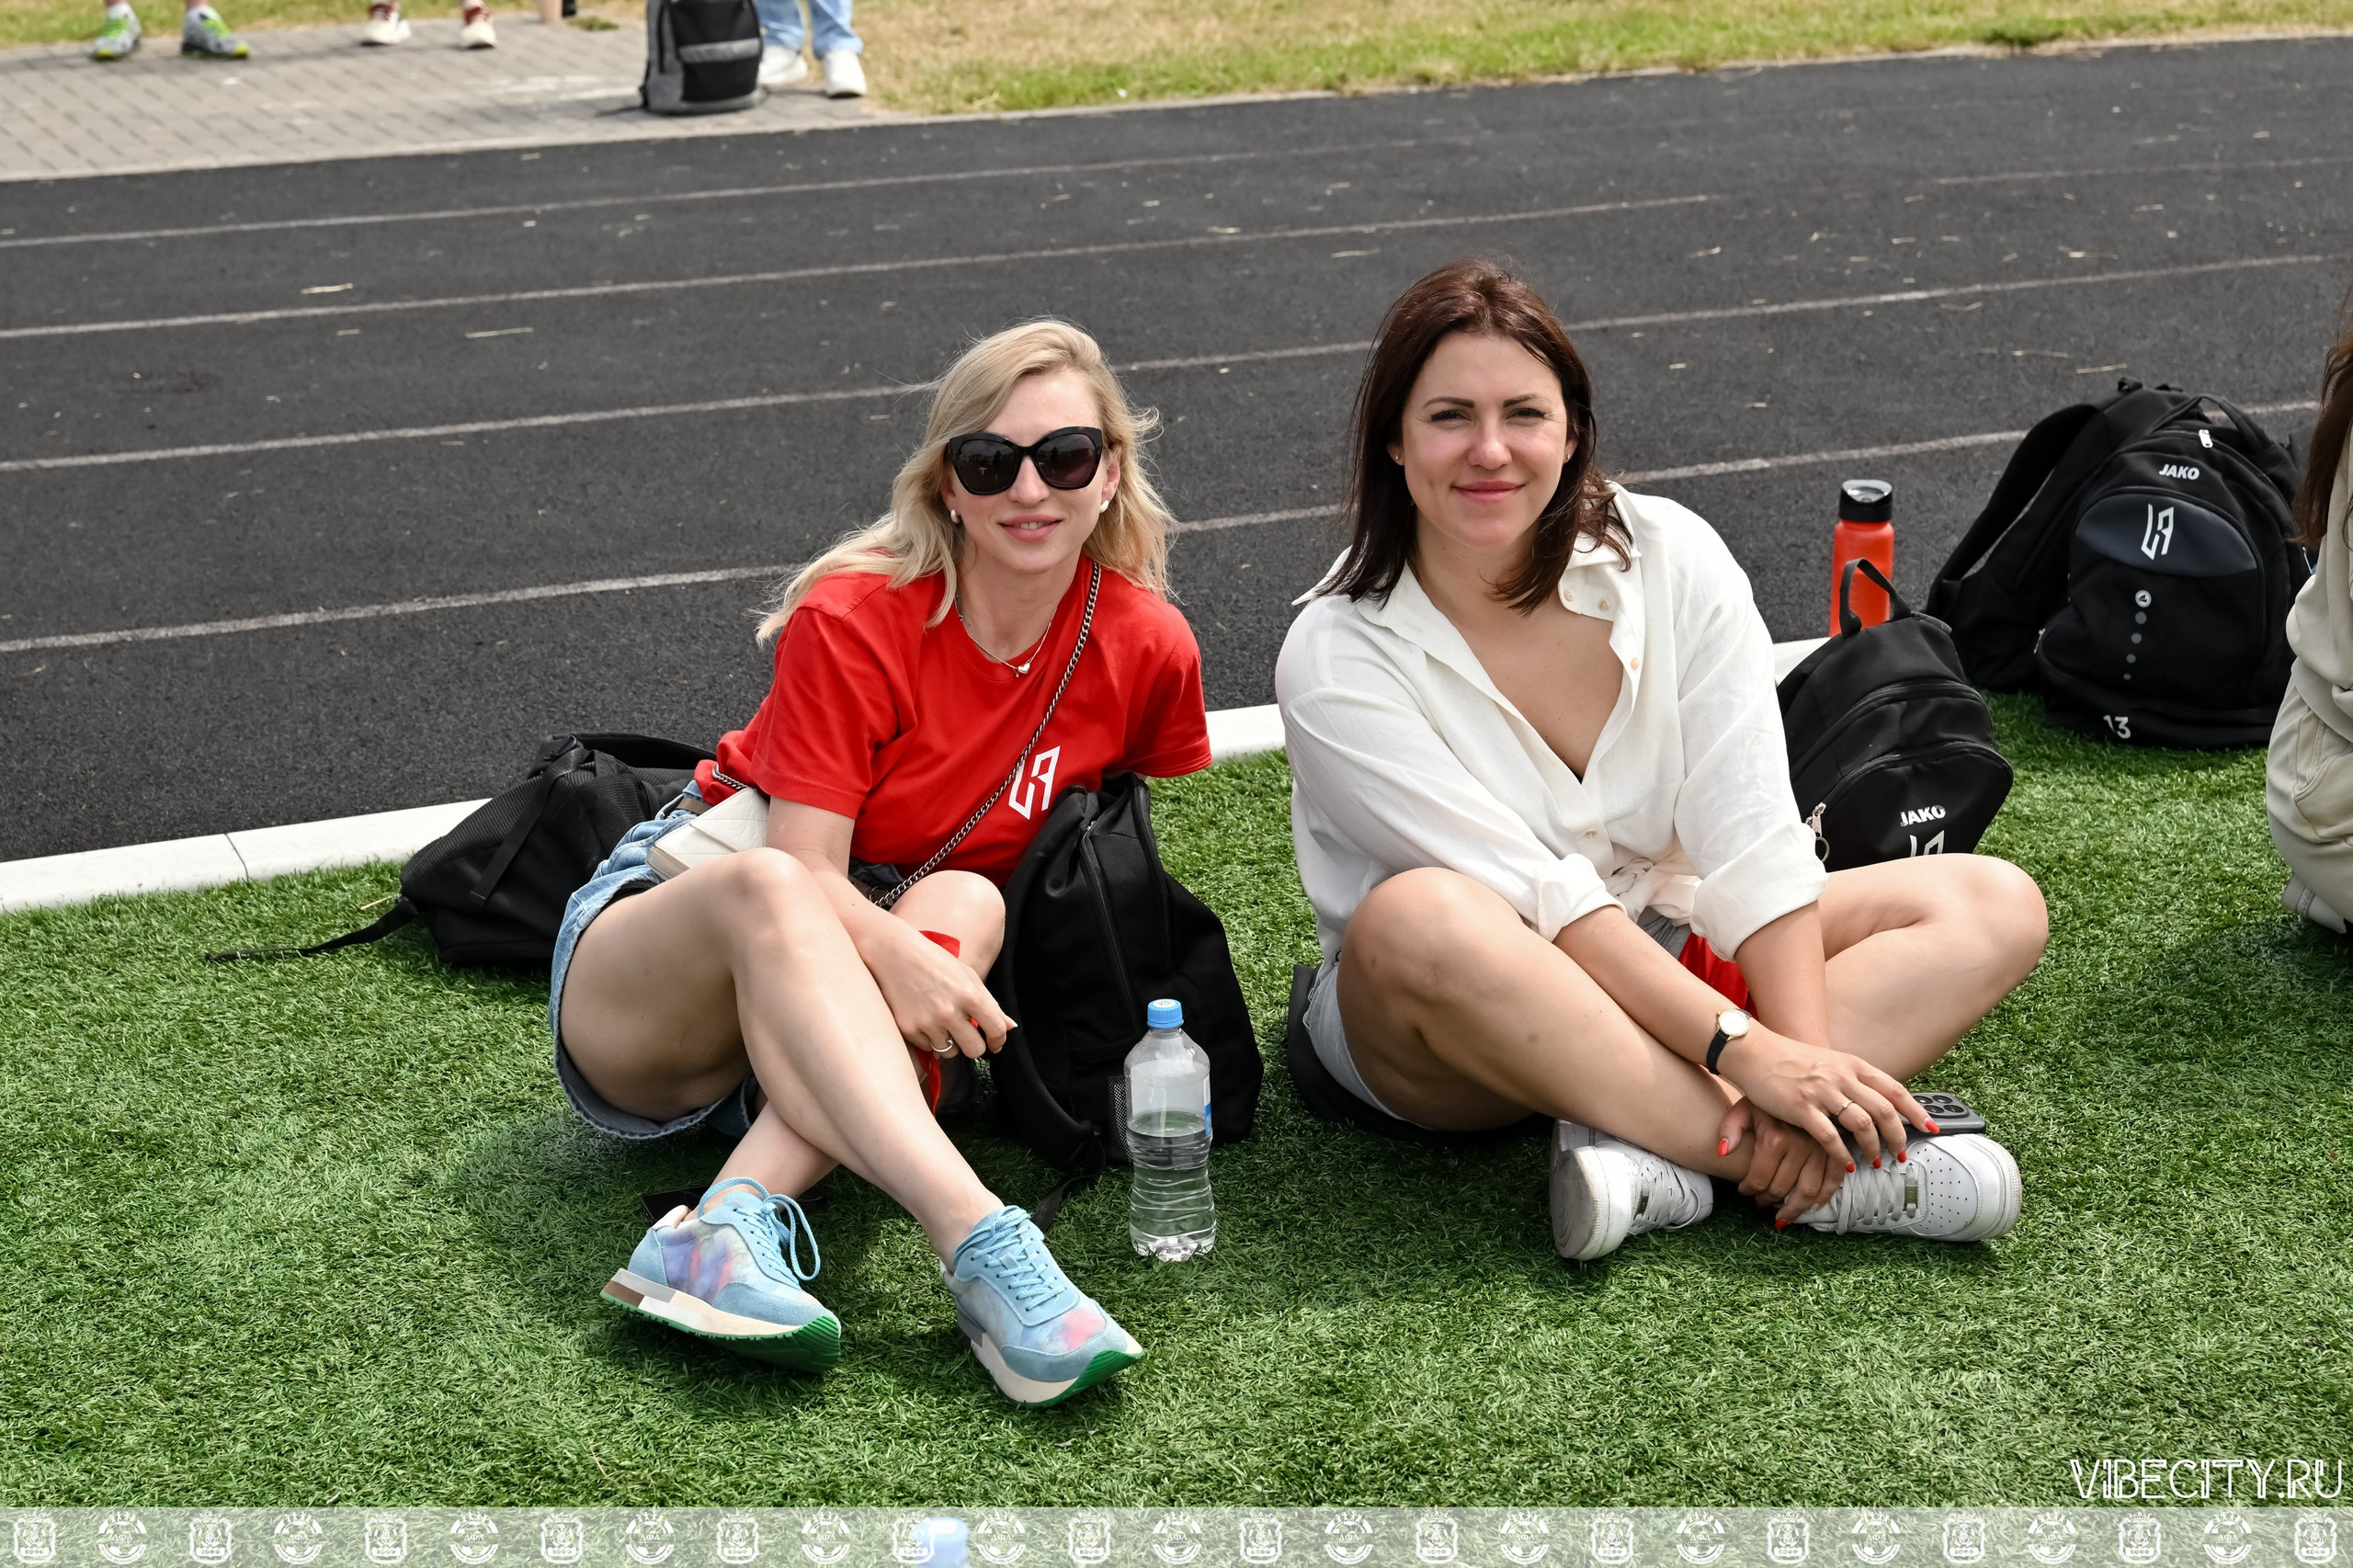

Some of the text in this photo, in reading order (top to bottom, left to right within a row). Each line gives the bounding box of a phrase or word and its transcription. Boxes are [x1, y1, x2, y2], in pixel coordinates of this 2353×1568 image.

[2158, 463, 2200, 481] JAKO
[2103, 715, 2131, 739] 13
[1900, 804, 1947, 827] JAKO
